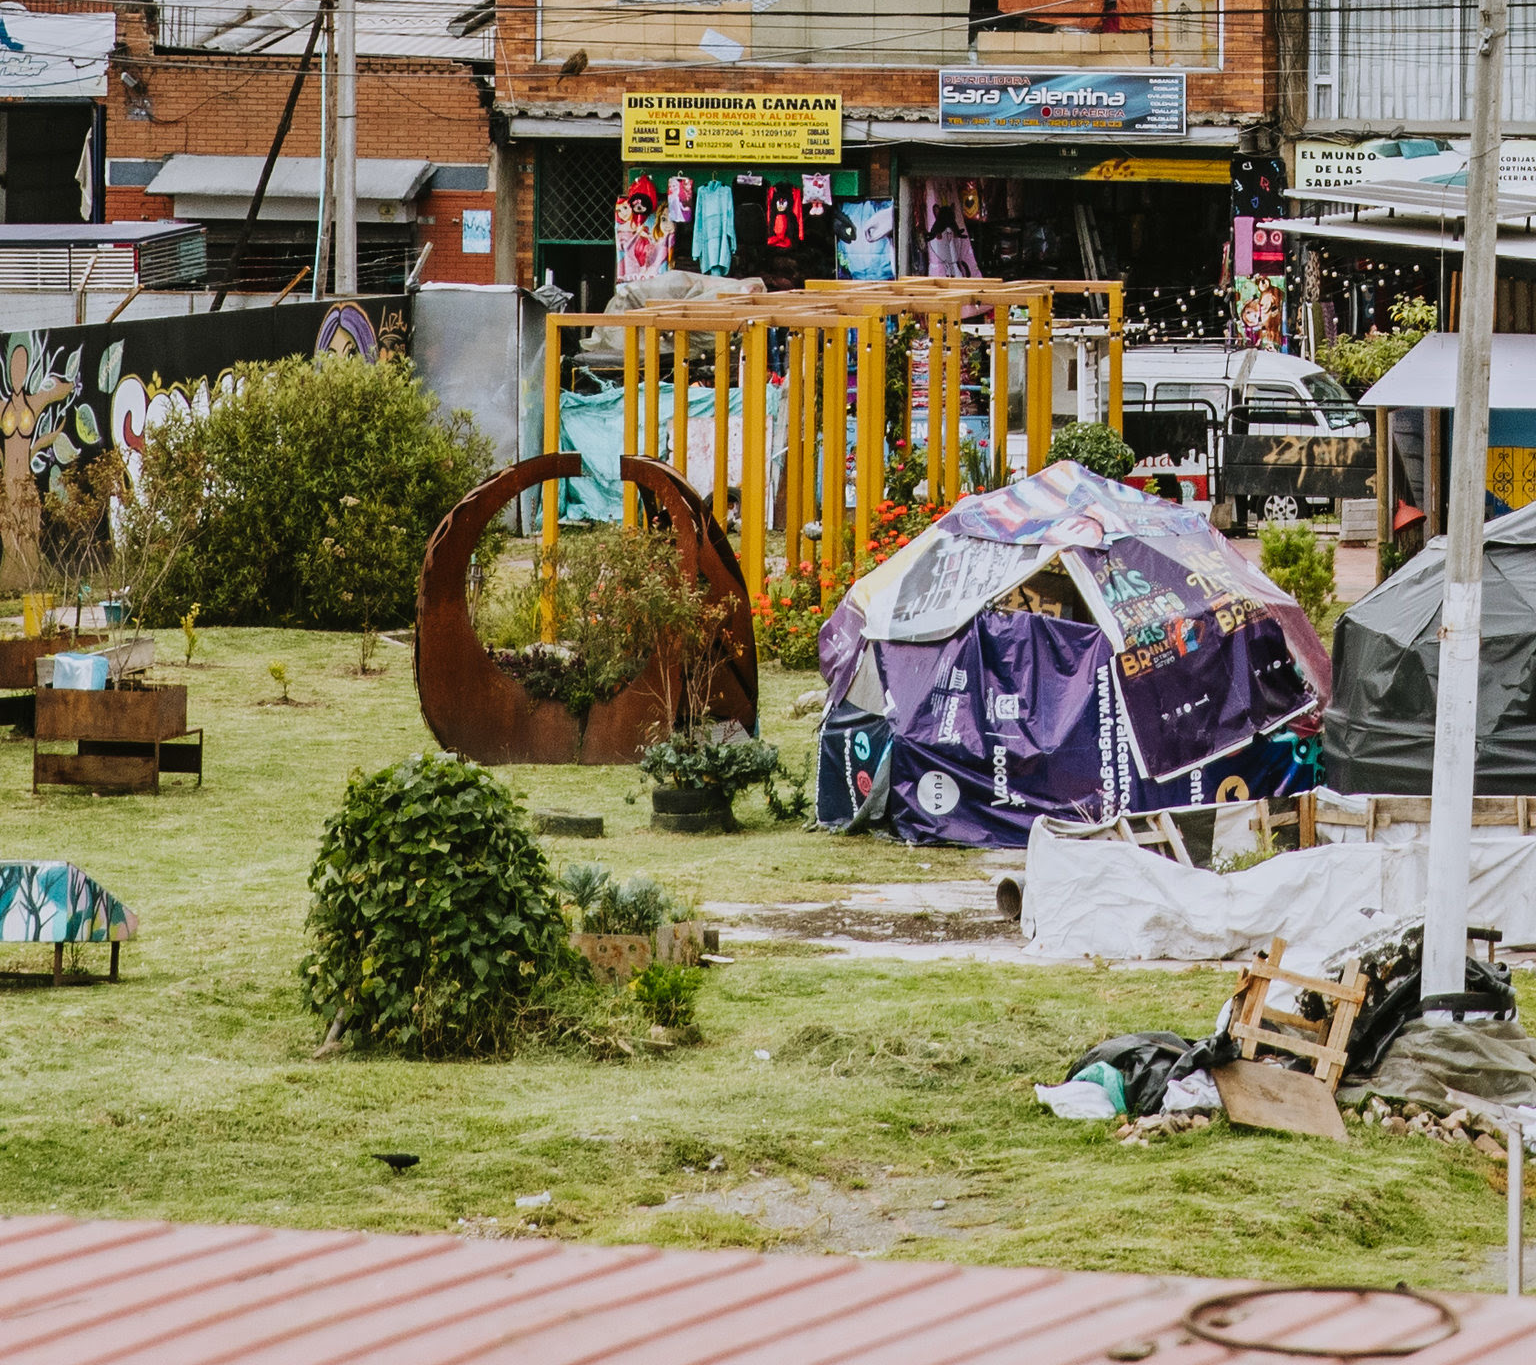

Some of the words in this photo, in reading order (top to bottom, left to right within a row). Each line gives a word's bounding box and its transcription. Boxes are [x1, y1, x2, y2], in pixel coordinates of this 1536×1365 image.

[943, 86, 1001, 105] Sara
[1007, 86, 1126, 107] Valentina
[627, 96, 756, 110] DISTRIBUIDORA
[762, 98, 837, 111] CANAAN
[647, 111, 681, 119] VENTA
[683, 111, 697, 119] AL
[699, 111, 719, 119] POR
[722, 111, 757, 120] MAYOR
[759, 112, 766, 120] Y
[769, 112, 782, 120] AL
[785, 112, 817, 120] DETAL
[1072, 108, 1126, 118] FABRICA
[1301, 150, 1316, 160] EL
[1321, 150, 1377, 161] MUNDO
[1315, 164, 1334, 174] DE
[1337, 165, 1362, 175] LAS
[1305, 178, 1371, 187] SABAN
[933, 773, 944, 811] FUGA
